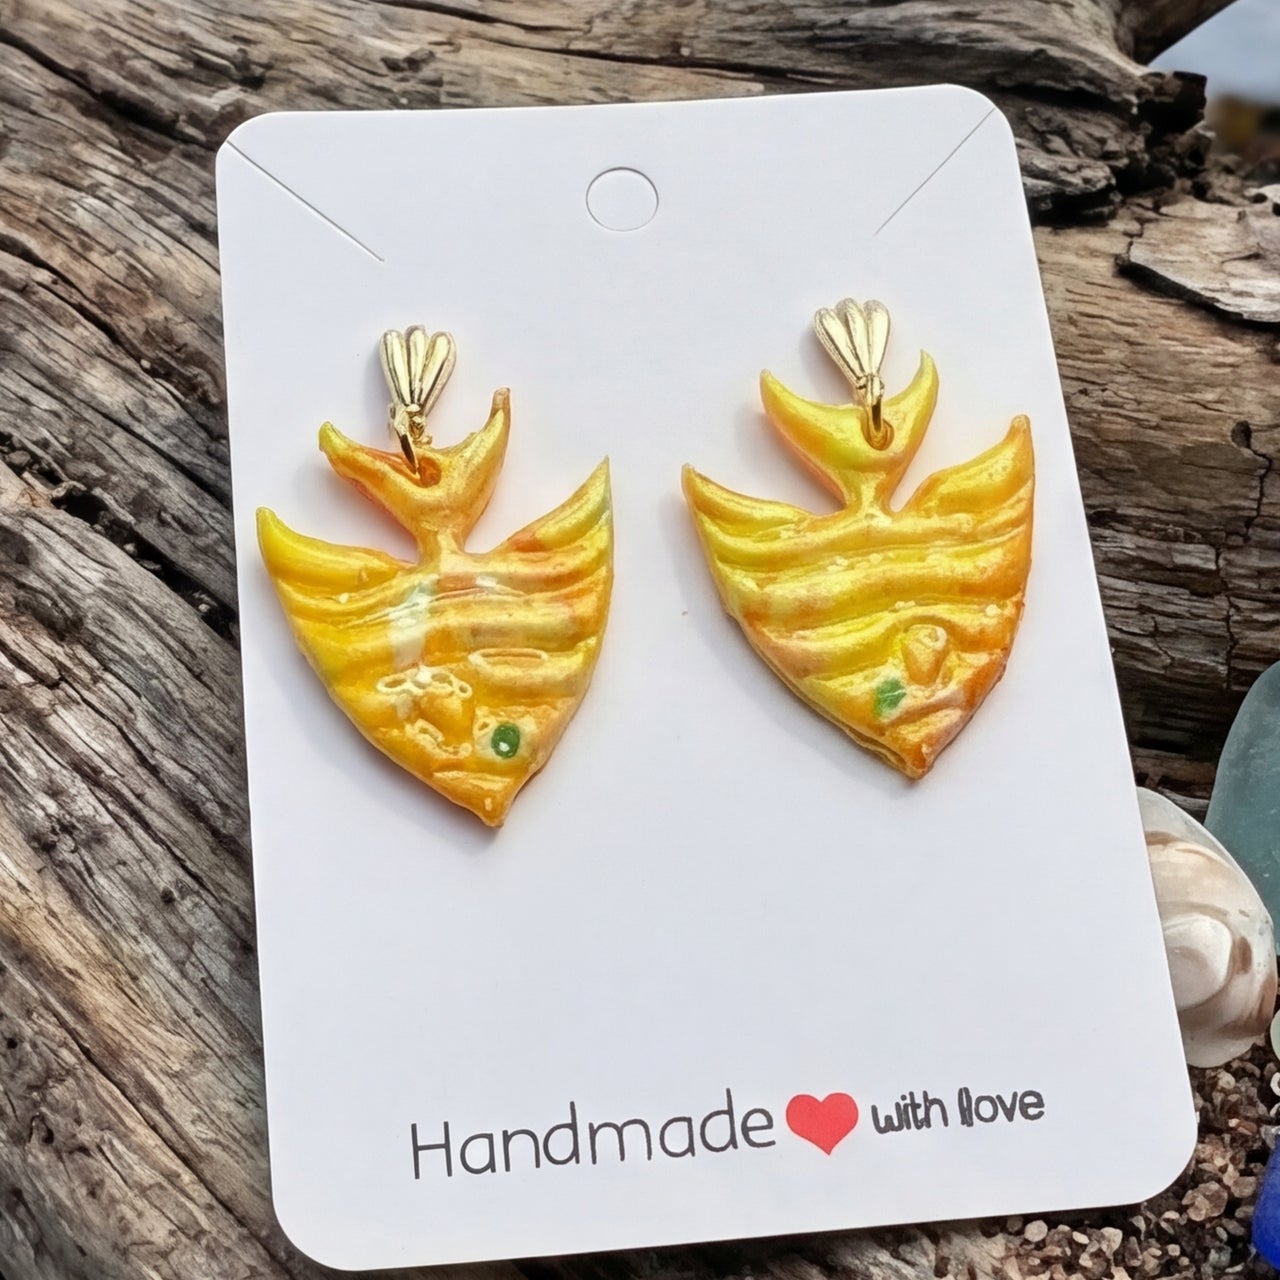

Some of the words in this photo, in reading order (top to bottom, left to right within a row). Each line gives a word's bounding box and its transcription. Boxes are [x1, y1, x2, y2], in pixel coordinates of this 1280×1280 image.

[410, 1087, 776, 1180] Handmade
[871, 1090, 949, 1135] with
[957, 1086, 1045, 1128] love
